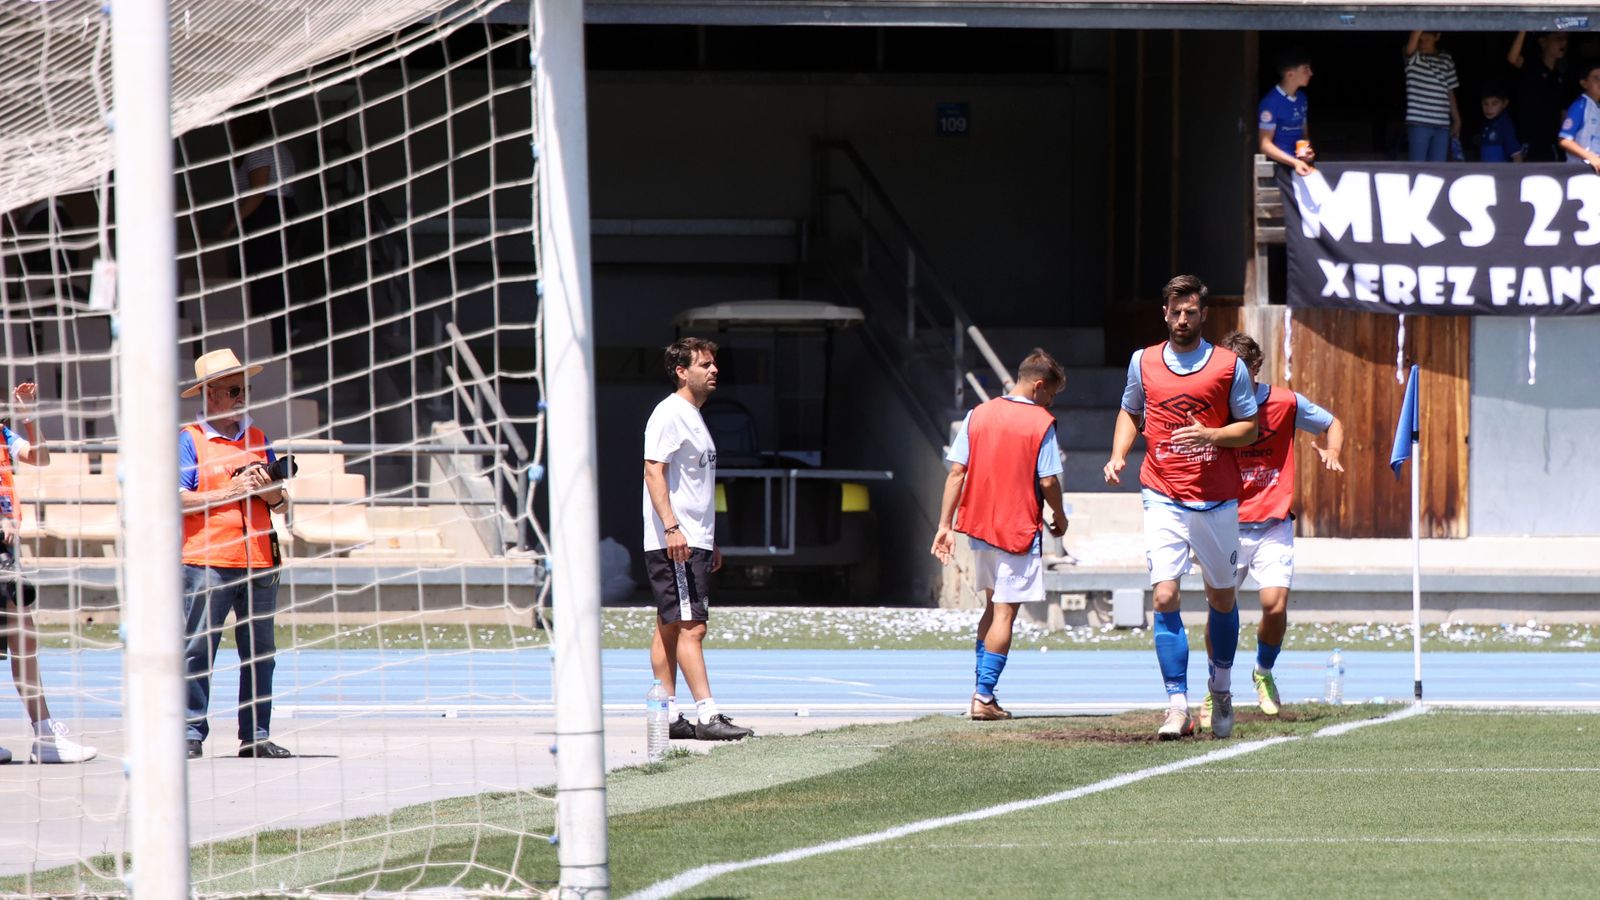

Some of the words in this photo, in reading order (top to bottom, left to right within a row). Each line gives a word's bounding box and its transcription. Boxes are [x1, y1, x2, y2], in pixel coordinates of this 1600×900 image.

[941, 117, 967, 132] 109
[1291, 170, 1498, 248] MKS
[1519, 173, 1600, 247] 23
[1317, 258, 1478, 306] XEREZ
[1488, 264, 1600, 306] FANS
